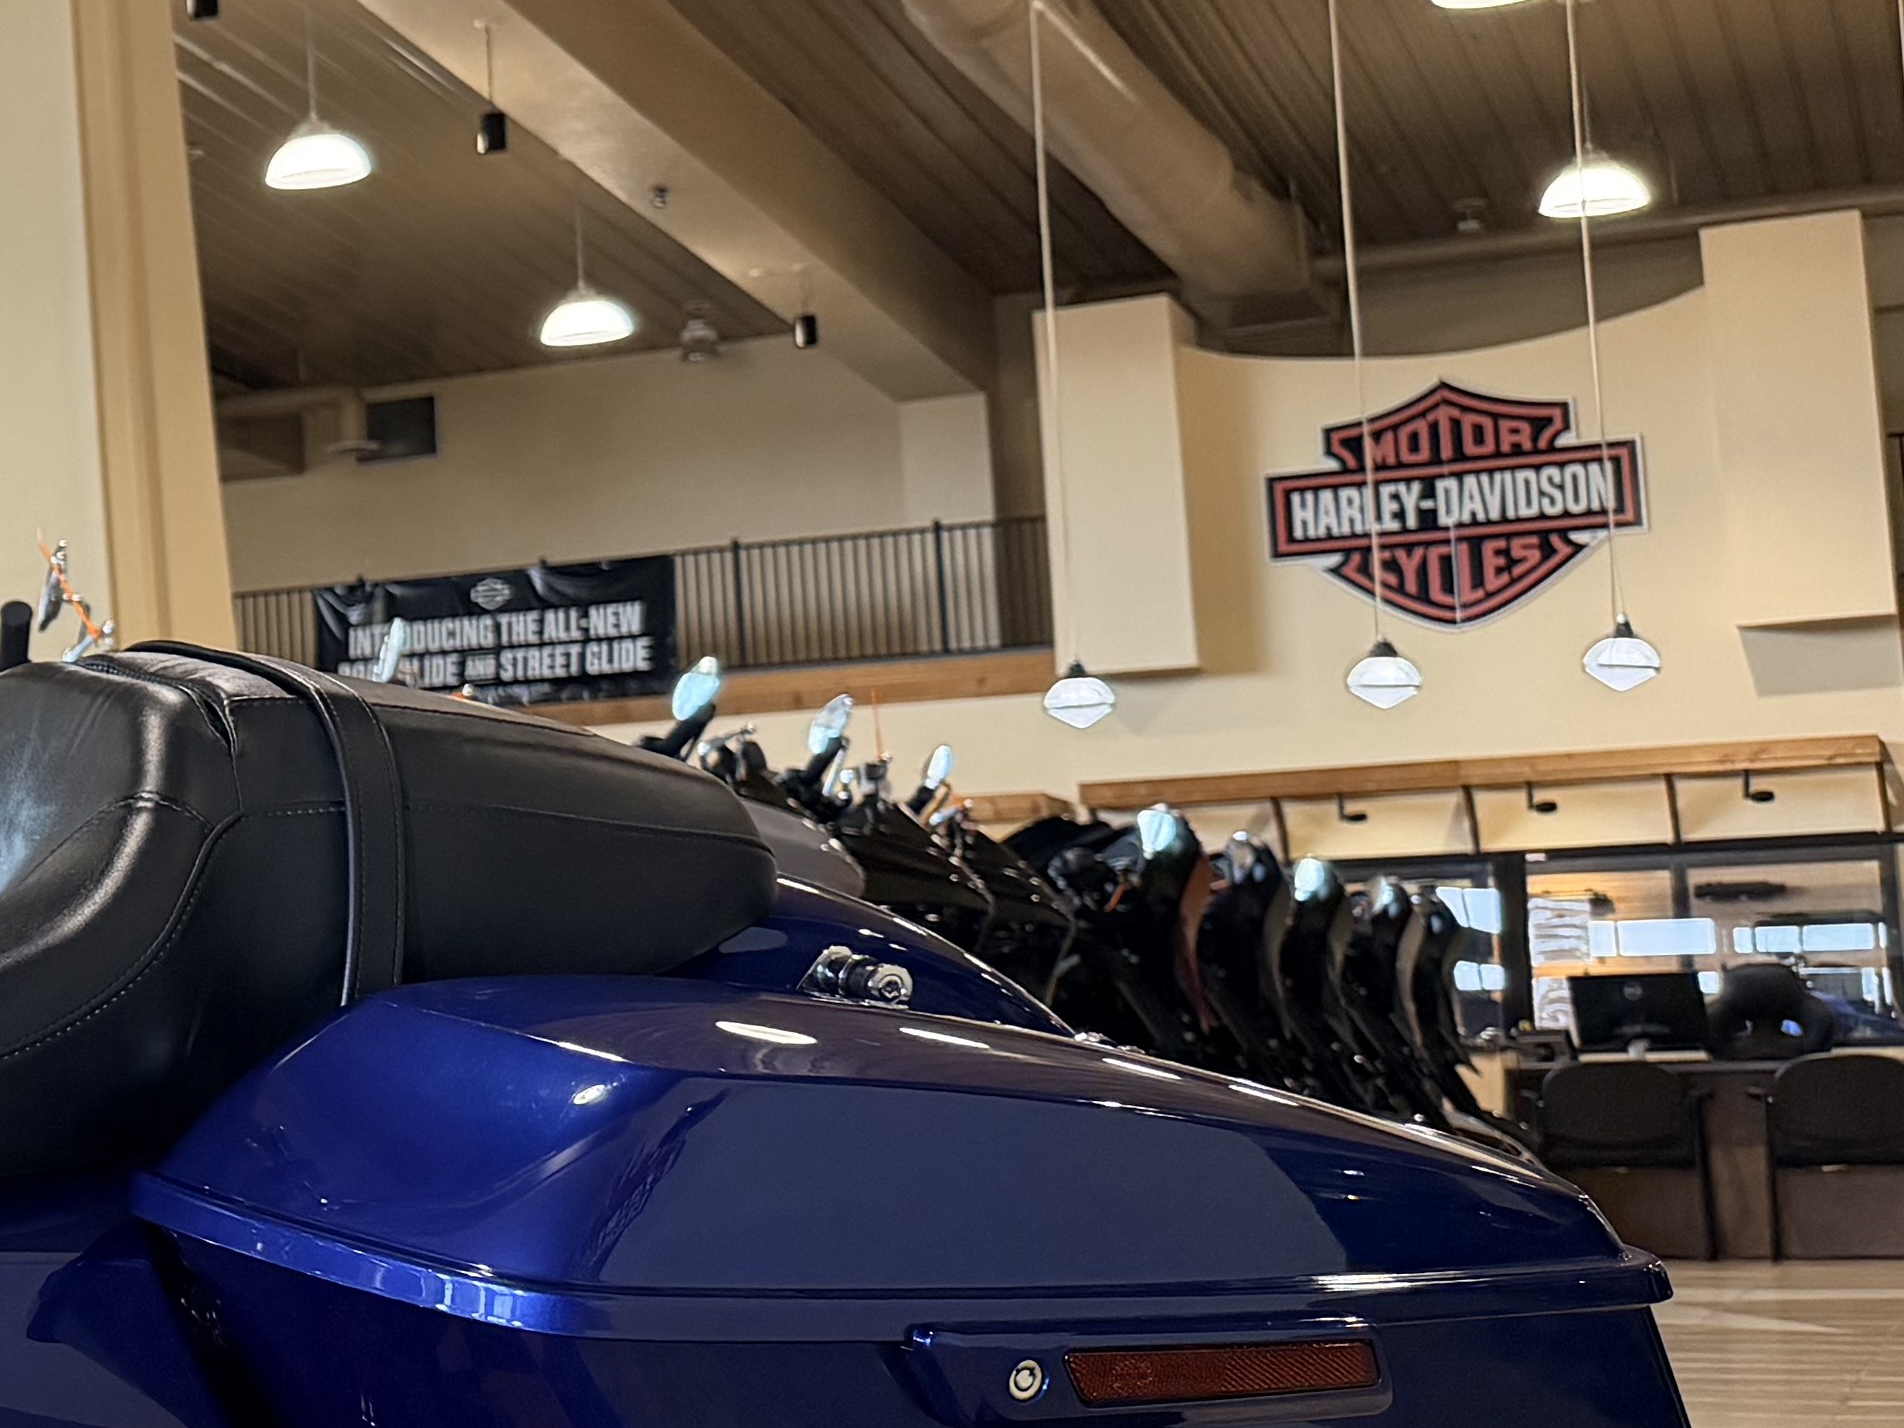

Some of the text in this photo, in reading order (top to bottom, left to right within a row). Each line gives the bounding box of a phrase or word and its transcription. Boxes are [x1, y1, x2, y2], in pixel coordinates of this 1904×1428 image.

[1368, 404, 1533, 467] MOTOR
[1291, 459, 1614, 541] HARLEY-DAVIDSON
[1369, 533, 1542, 609] CYCLES
[348, 600, 645, 660] INTODUCING THE ALL-NEW
[499, 642, 583, 683] STREET
[585, 636, 656, 675] GLIDE
